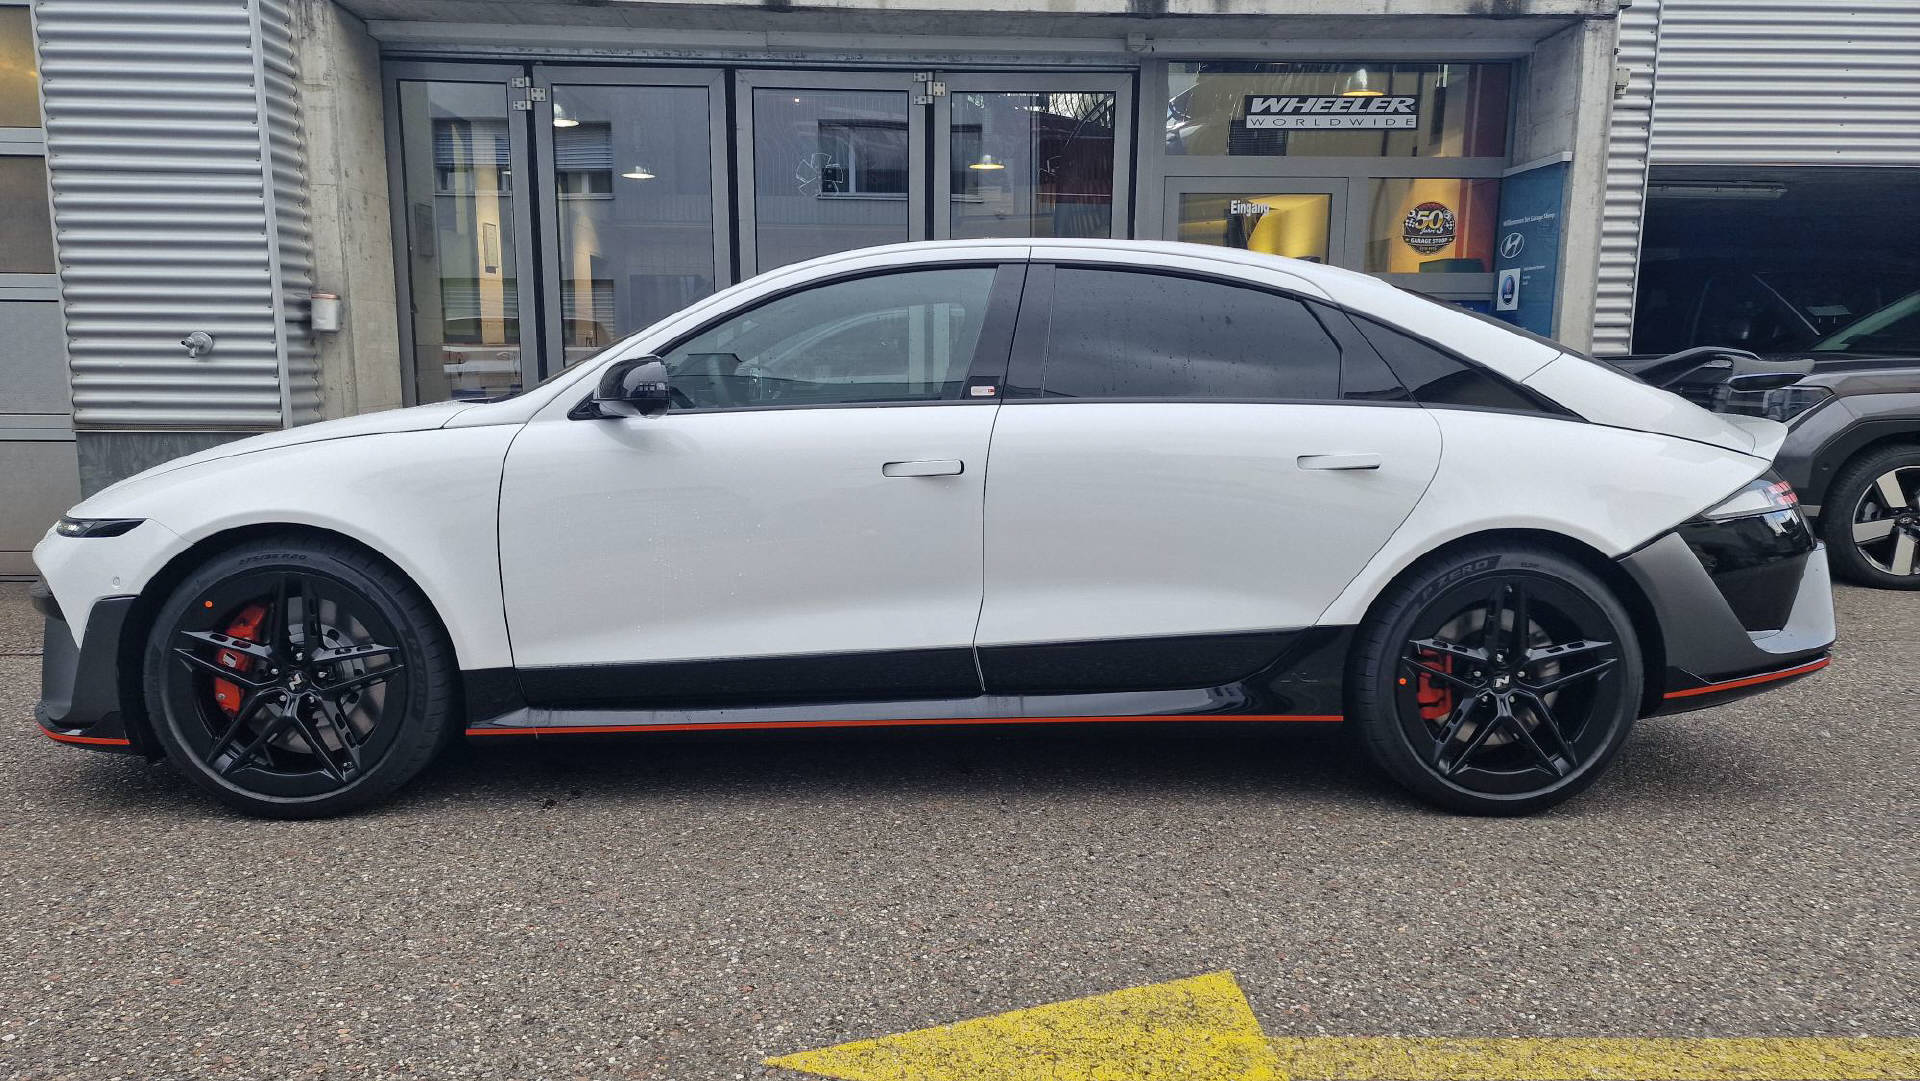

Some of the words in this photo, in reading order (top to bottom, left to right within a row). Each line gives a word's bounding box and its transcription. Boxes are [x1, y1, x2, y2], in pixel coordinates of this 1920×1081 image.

[1250, 97, 1416, 113] WHEELER
[1250, 118, 1415, 127] WORLDWIDE
[1230, 199, 1270, 217] Eingang
[1415, 210, 1444, 230] 50
